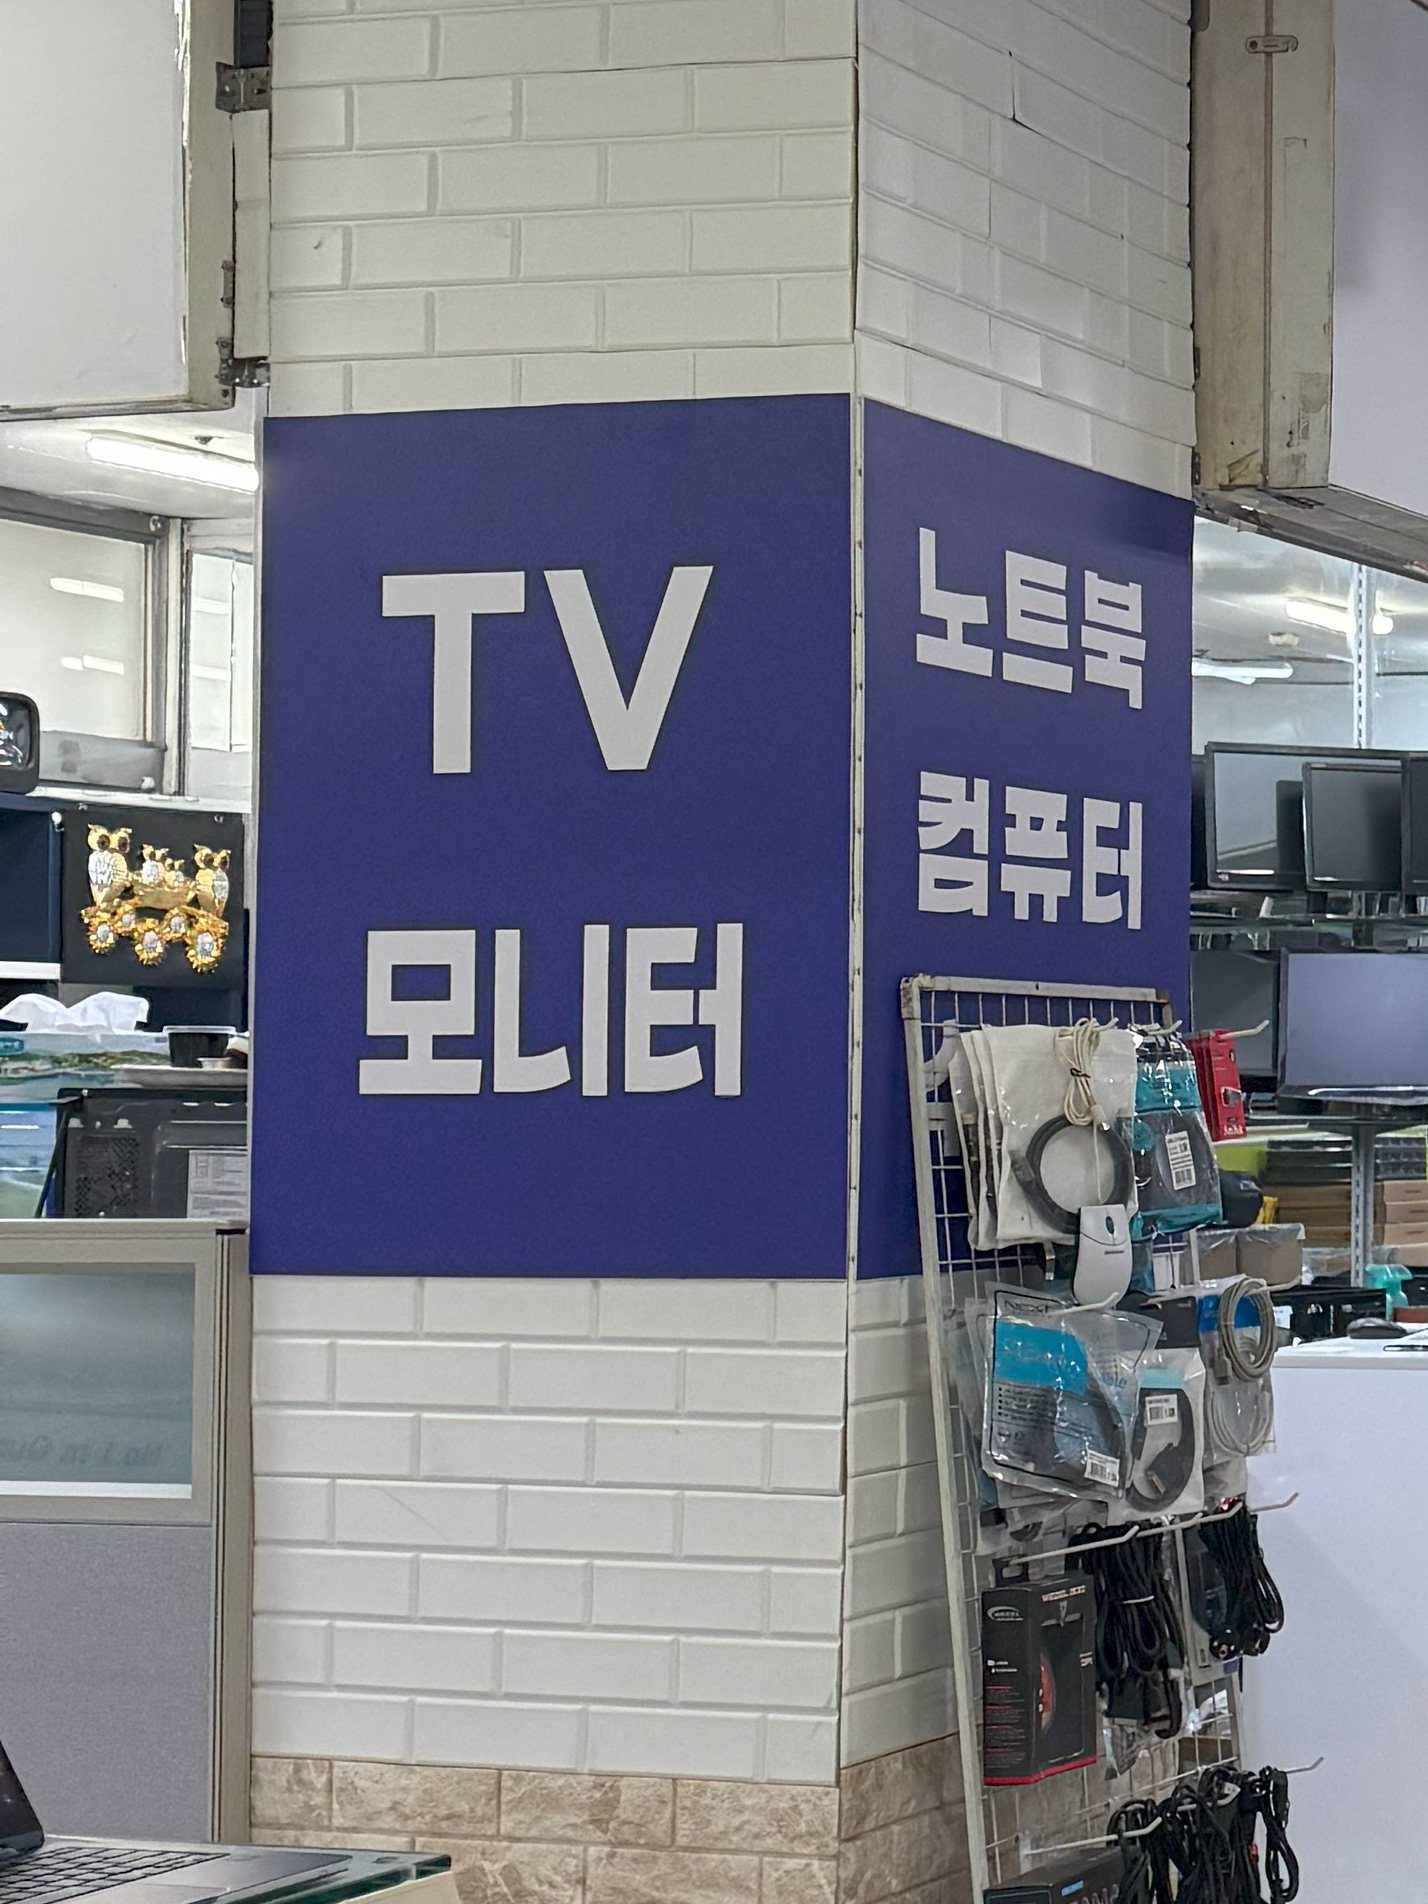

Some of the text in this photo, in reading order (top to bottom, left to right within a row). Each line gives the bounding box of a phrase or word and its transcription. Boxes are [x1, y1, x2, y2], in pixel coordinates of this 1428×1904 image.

[380, 565, 715, 775] TV
[916, 527, 1147, 710] 노트북
[917, 770, 1144, 931] 컴퓨터
[358, 922, 744, 1097] 모니터
